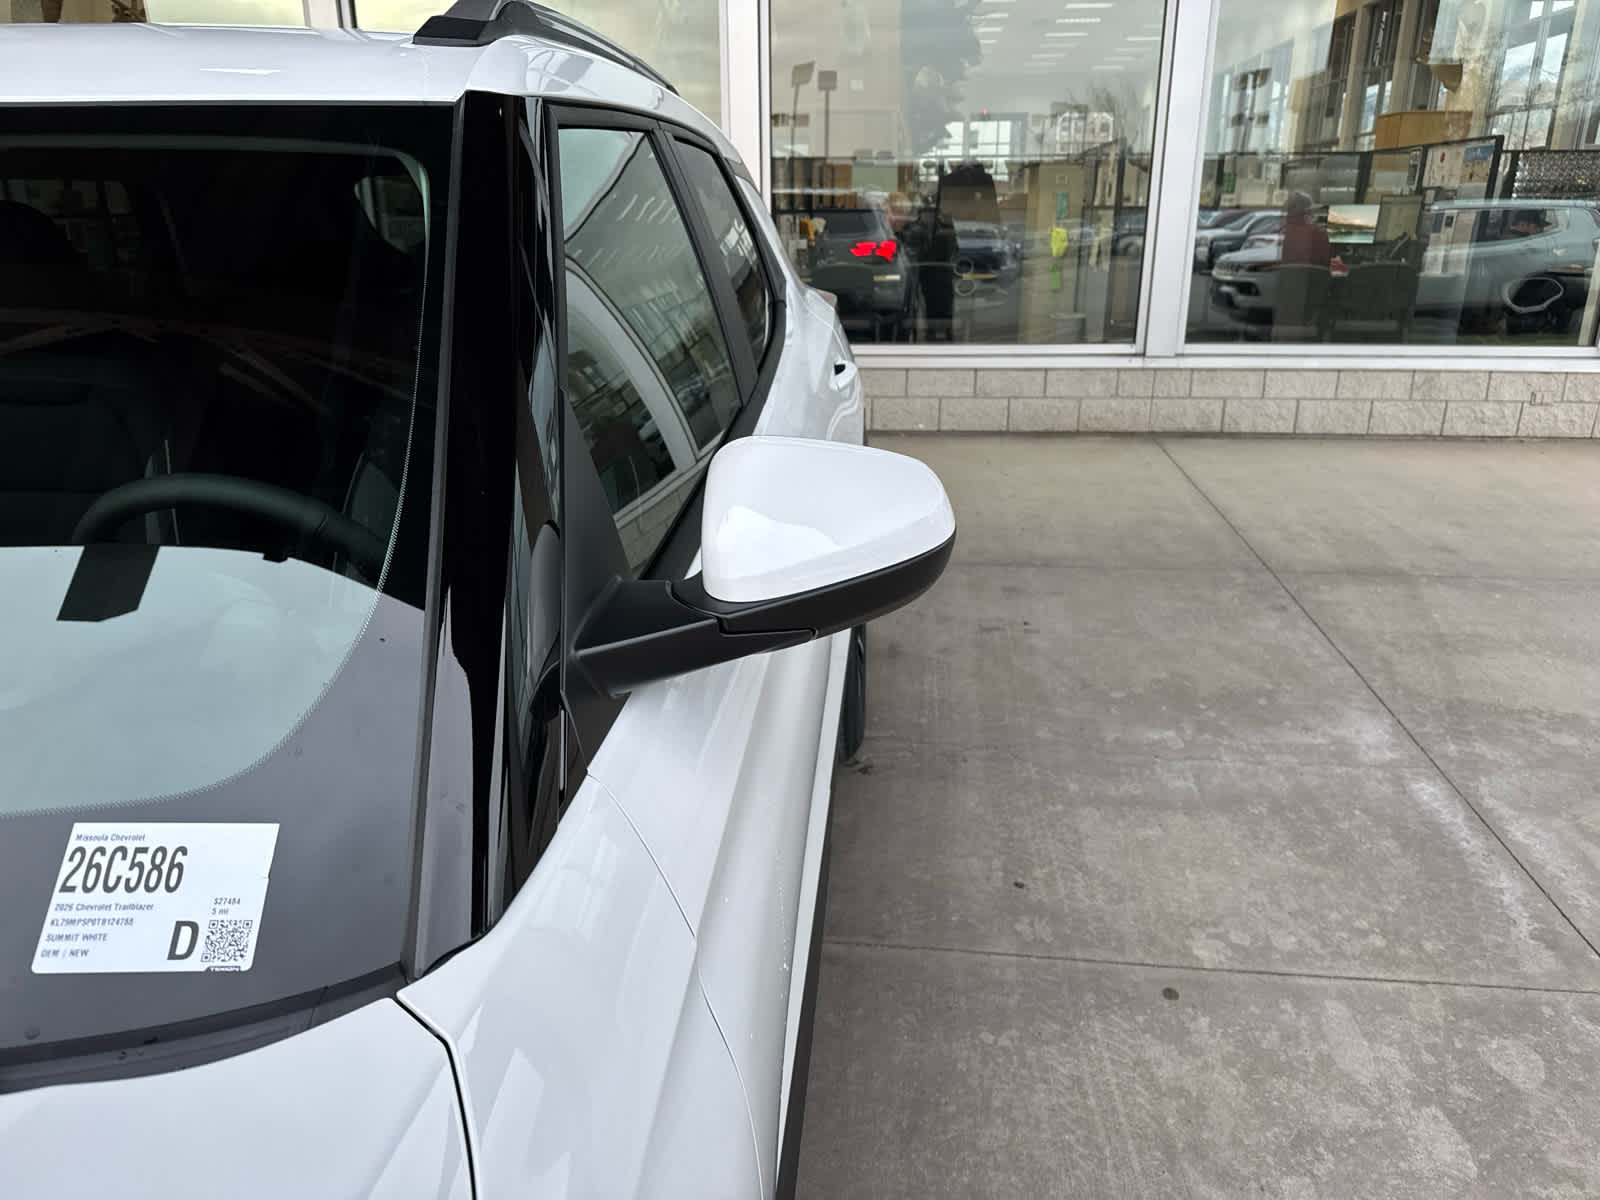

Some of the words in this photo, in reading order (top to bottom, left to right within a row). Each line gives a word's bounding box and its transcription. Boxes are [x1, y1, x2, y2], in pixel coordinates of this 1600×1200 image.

[75, 833, 109, 842] Missoula
[110, 833, 146, 842] Chevrolet
[59, 845, 188, 894] 26C586
[75, 903, 112, 912] Chevrolet
[114, 903, 154, 911] Trailblazer
[44, 933, 80, 942] SUMMIT
[81, 933, 109, 942] WHITE
[166, 920, 199, 961] D
[69, 948, 89, 957] NEW
